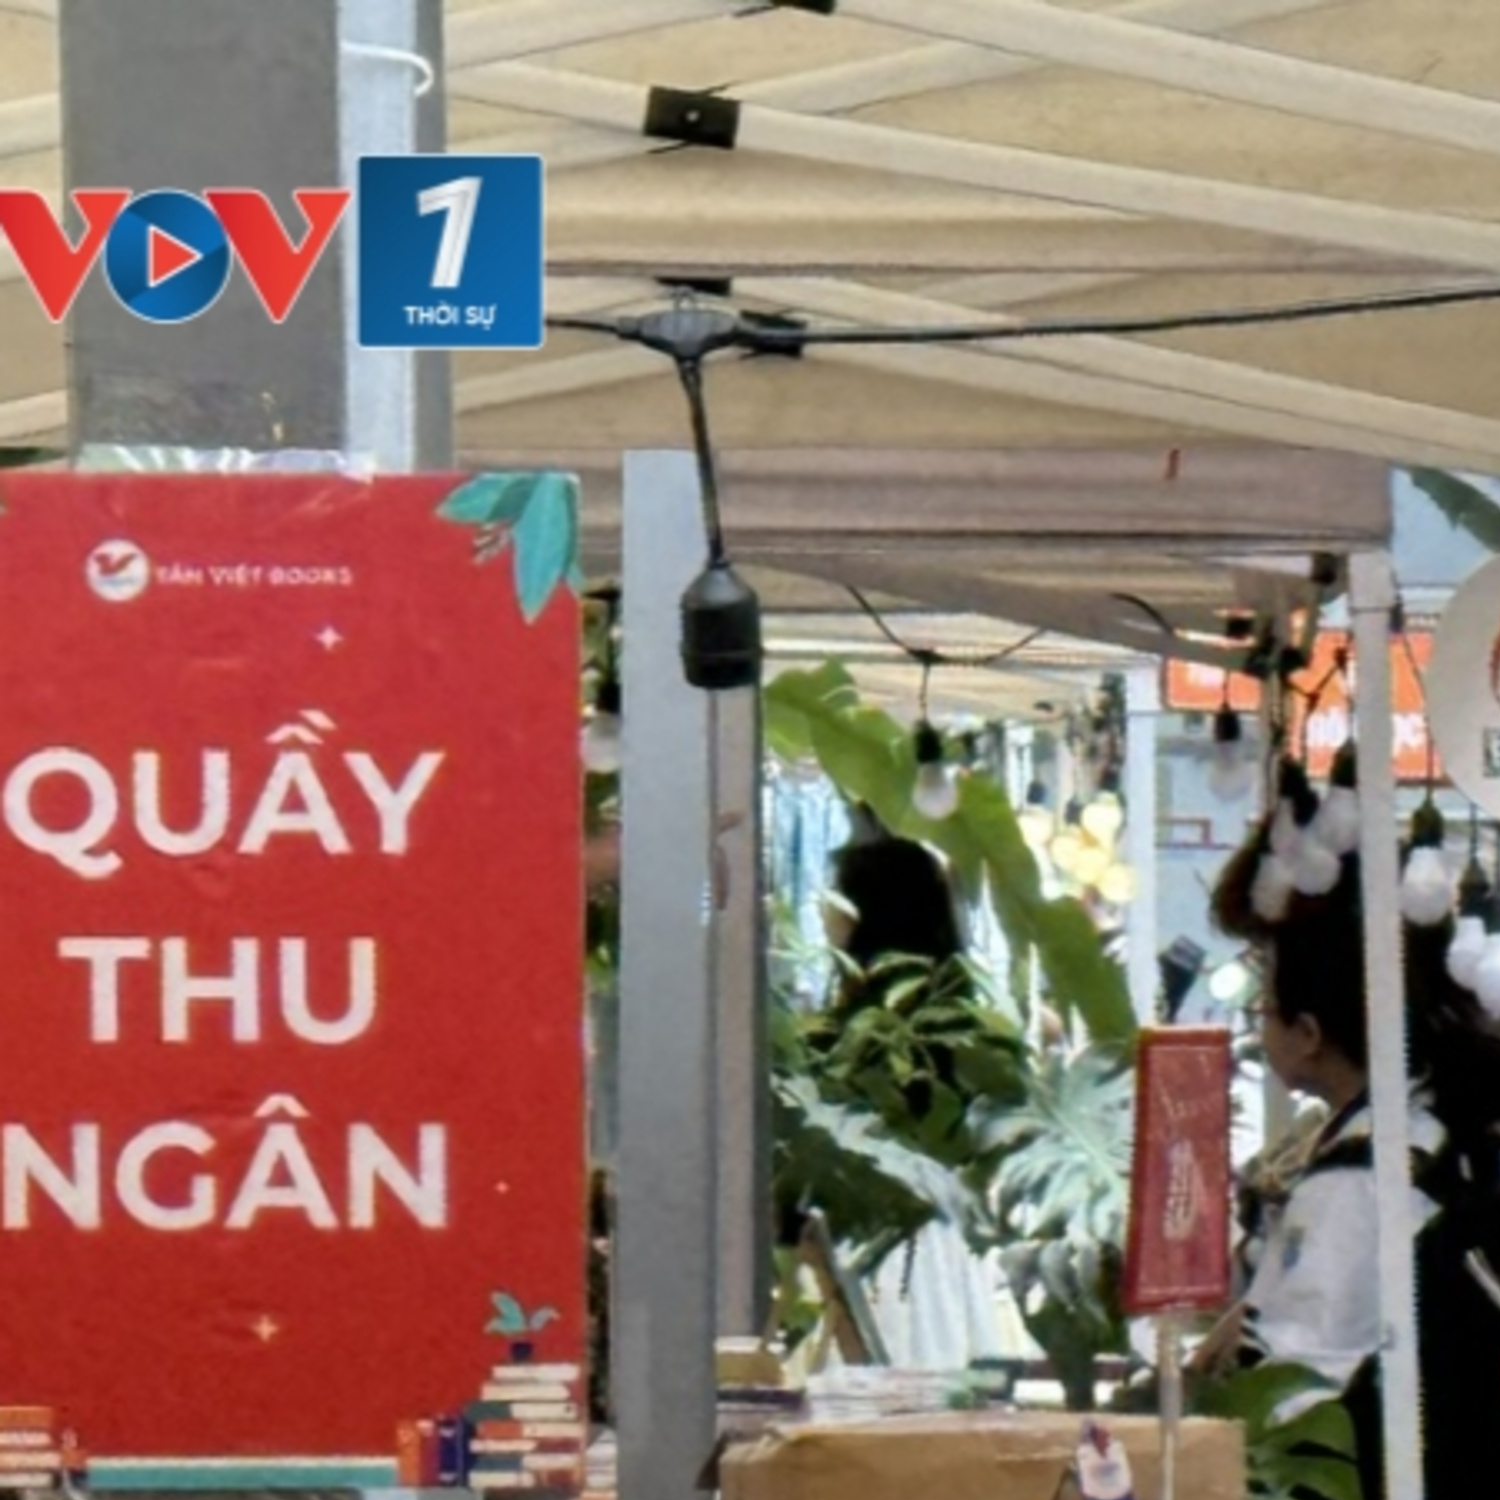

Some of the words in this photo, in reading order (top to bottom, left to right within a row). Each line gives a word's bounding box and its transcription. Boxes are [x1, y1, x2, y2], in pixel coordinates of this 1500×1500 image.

[2, 709, 446, 880] QUẦY
[58, 936, 378, 1045] THU
[1, 1093, 449, 1230] NGÂN
